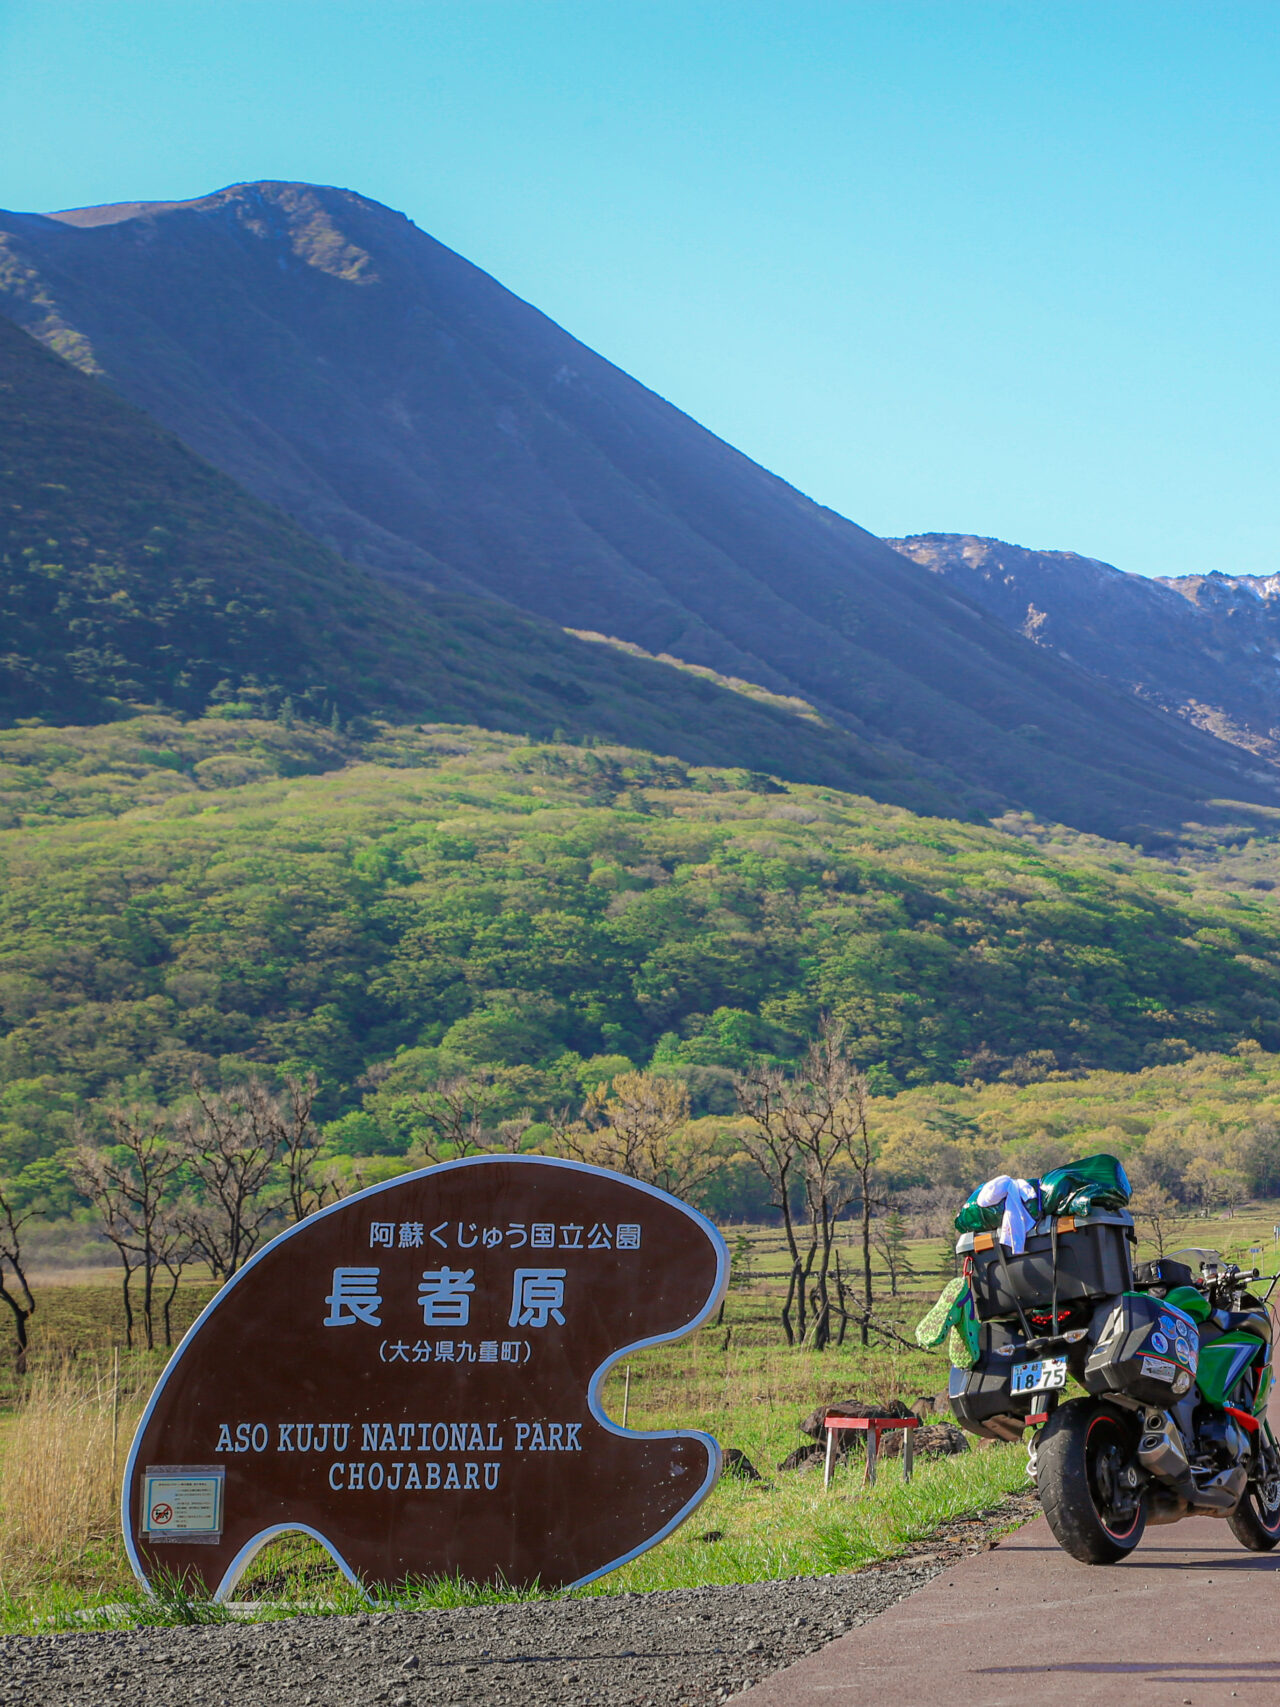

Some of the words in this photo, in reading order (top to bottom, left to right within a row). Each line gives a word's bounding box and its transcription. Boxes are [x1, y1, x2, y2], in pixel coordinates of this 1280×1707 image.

[369, 1221, 641, 1251] 阿蘇くじゅう国立公園
[323, 1265, 568, 1328] 長者原
[379, 1340, 531, 1364] (大分県九重町)
[215, 1424, 269, 1453] ASO
[277, 1423, 351, 1452] KUJU
[360, 1422, 503, 1452] NATIONAL
[514, 1422, 583, 1451] PARK
[328, 1462, 501, 1491] CHOJABARU
